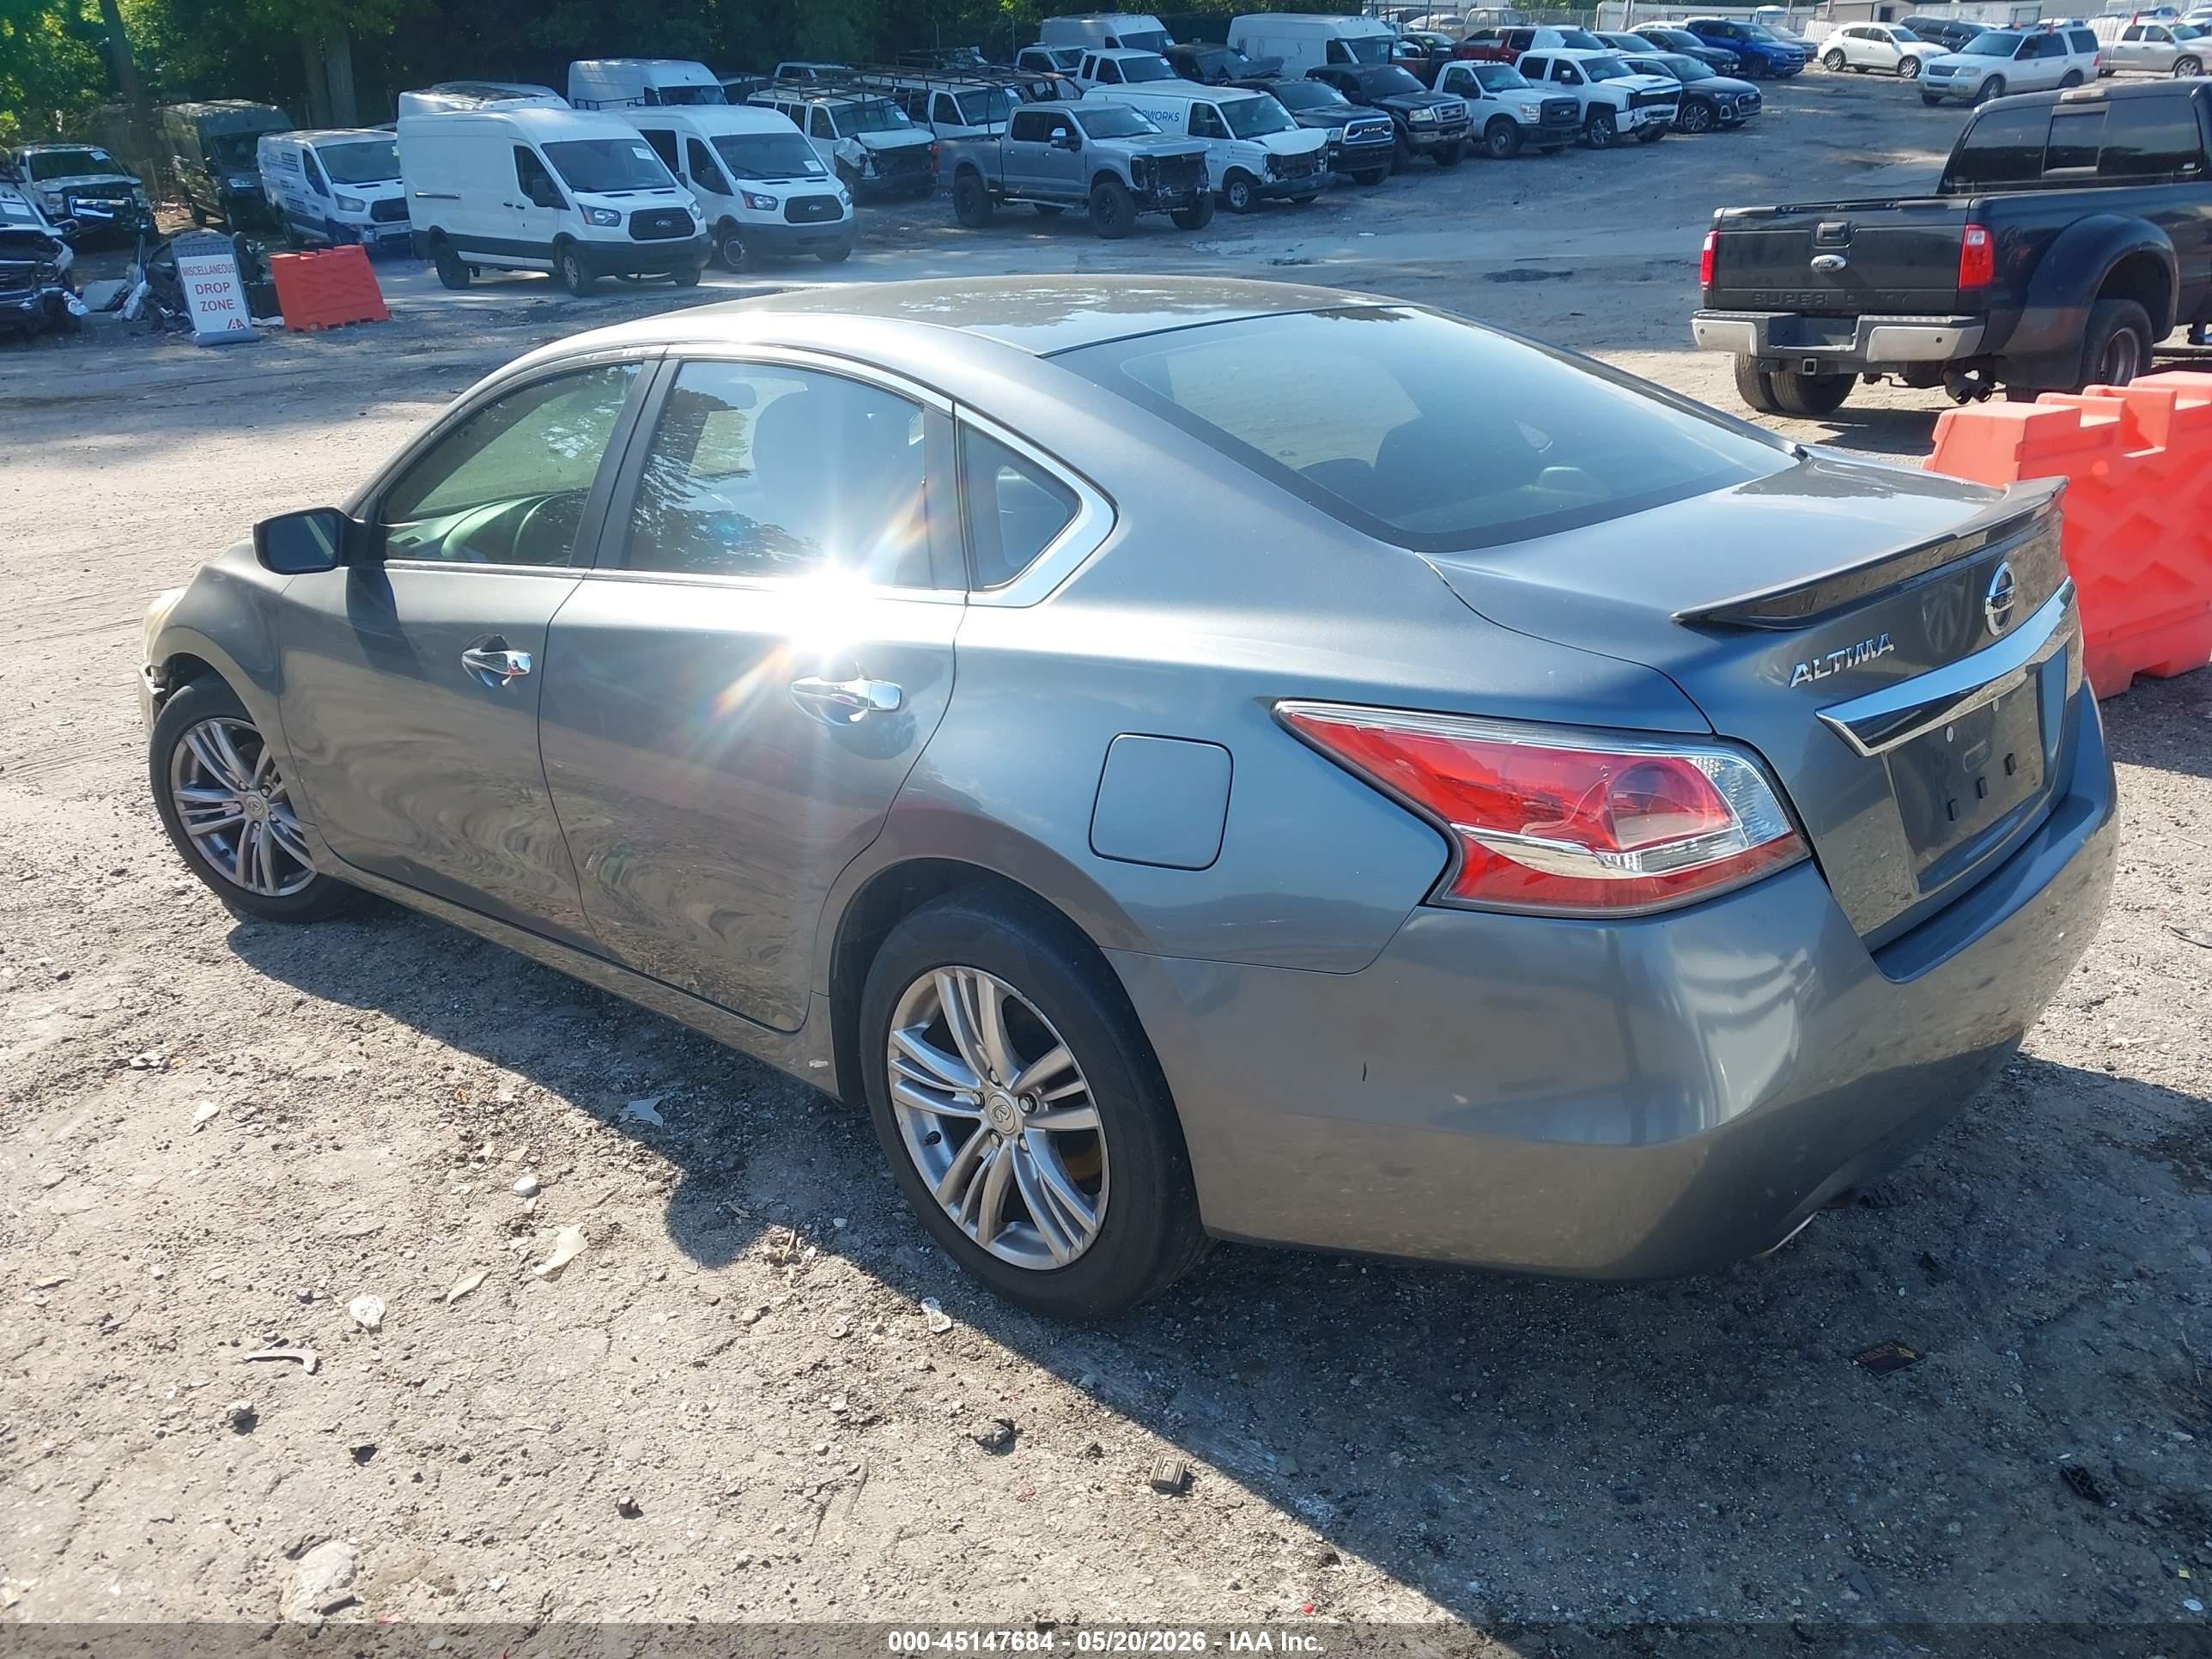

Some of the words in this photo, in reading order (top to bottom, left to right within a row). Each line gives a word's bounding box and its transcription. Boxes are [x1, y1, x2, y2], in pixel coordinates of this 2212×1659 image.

[181, 264, 235, 276] MISCELLANEOUS
[195, 282, 230, 295] DROP
[199, 299, 235, 312] ZONE
[1789, 632, 1895, 689] ALTIMA
